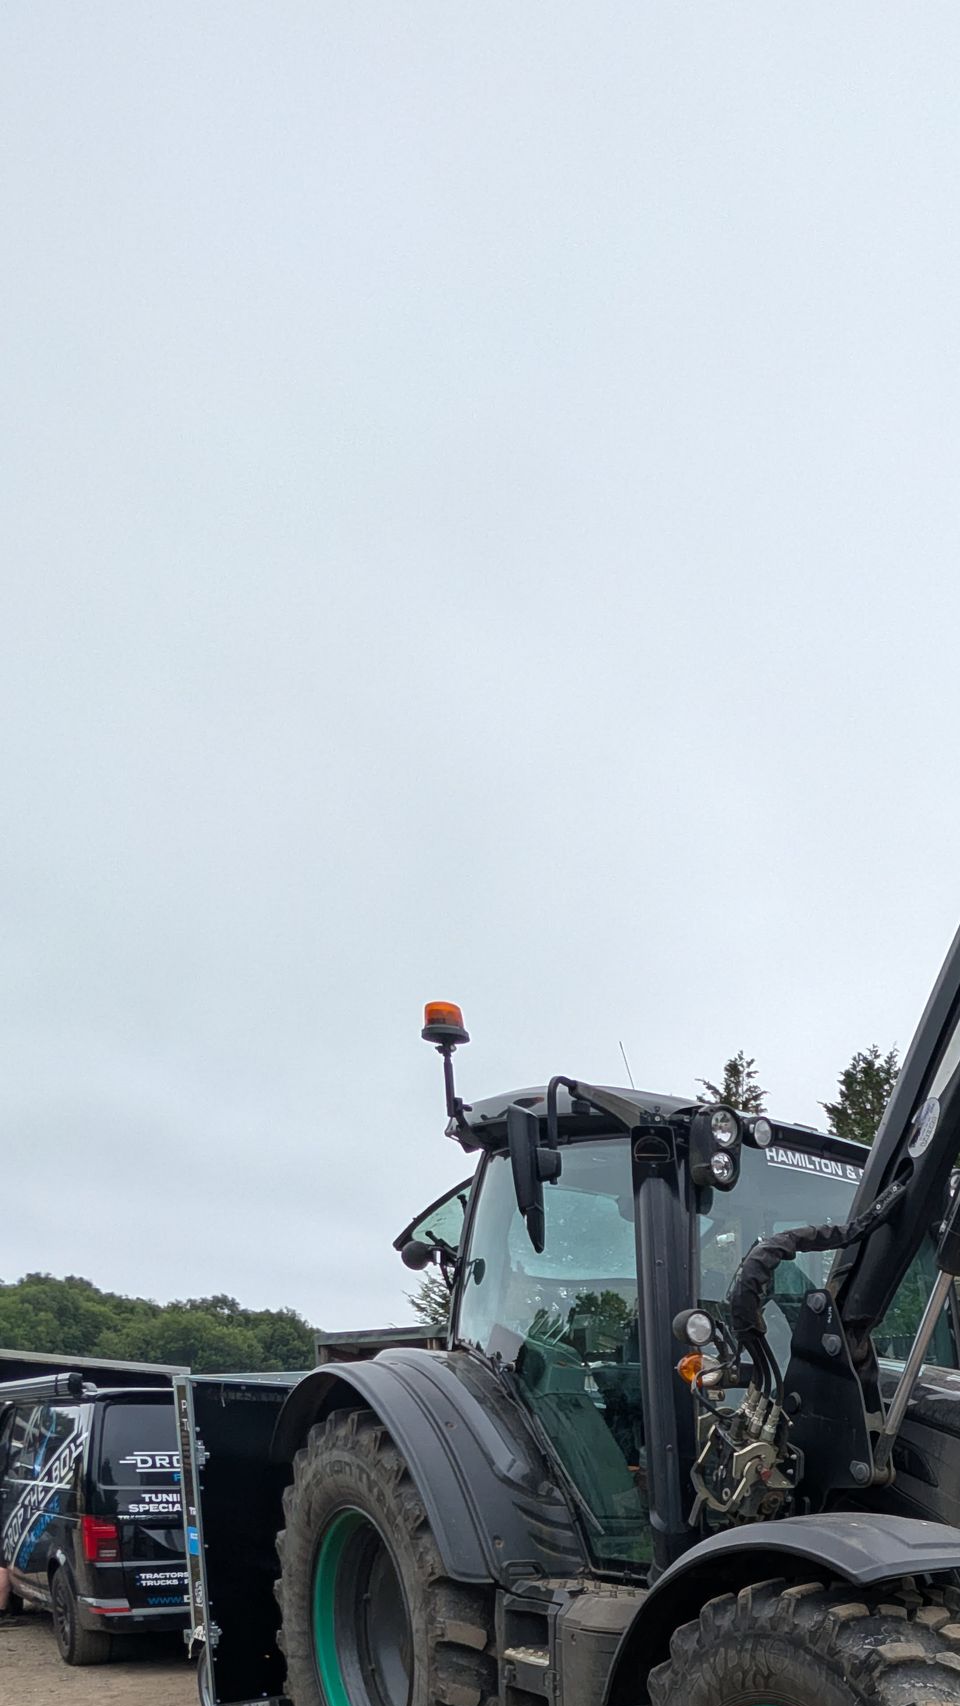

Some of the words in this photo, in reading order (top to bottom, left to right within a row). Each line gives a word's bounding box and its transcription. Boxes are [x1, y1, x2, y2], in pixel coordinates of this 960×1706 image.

[765, 1147, 843, 1176] HAMILTON
[846, 1165, 858, 1179] &
[140, 1579, 179, 1587] TRUCKS
